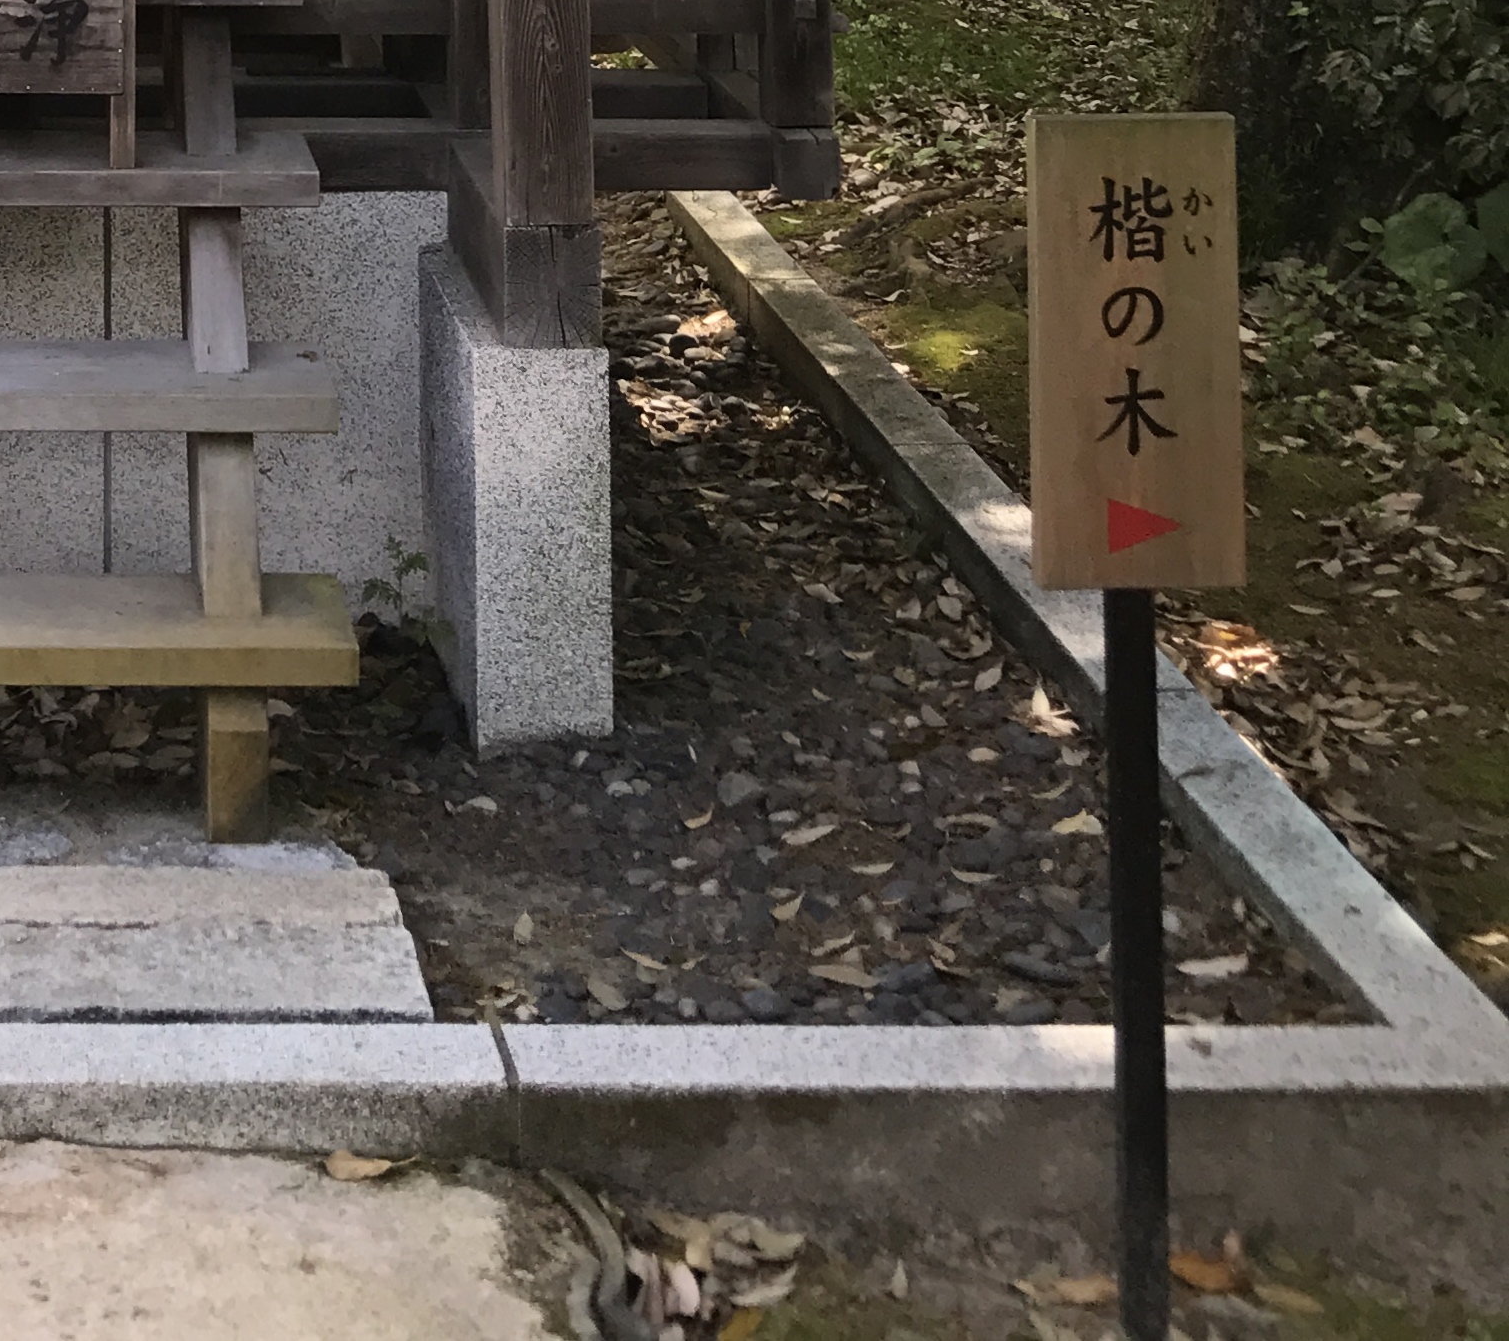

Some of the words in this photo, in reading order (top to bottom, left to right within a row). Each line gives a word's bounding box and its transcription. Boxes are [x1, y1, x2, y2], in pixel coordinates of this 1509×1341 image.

[1182, 186, 1214, 257] かい
[1087, 176, 1179, 457] 楷の木
